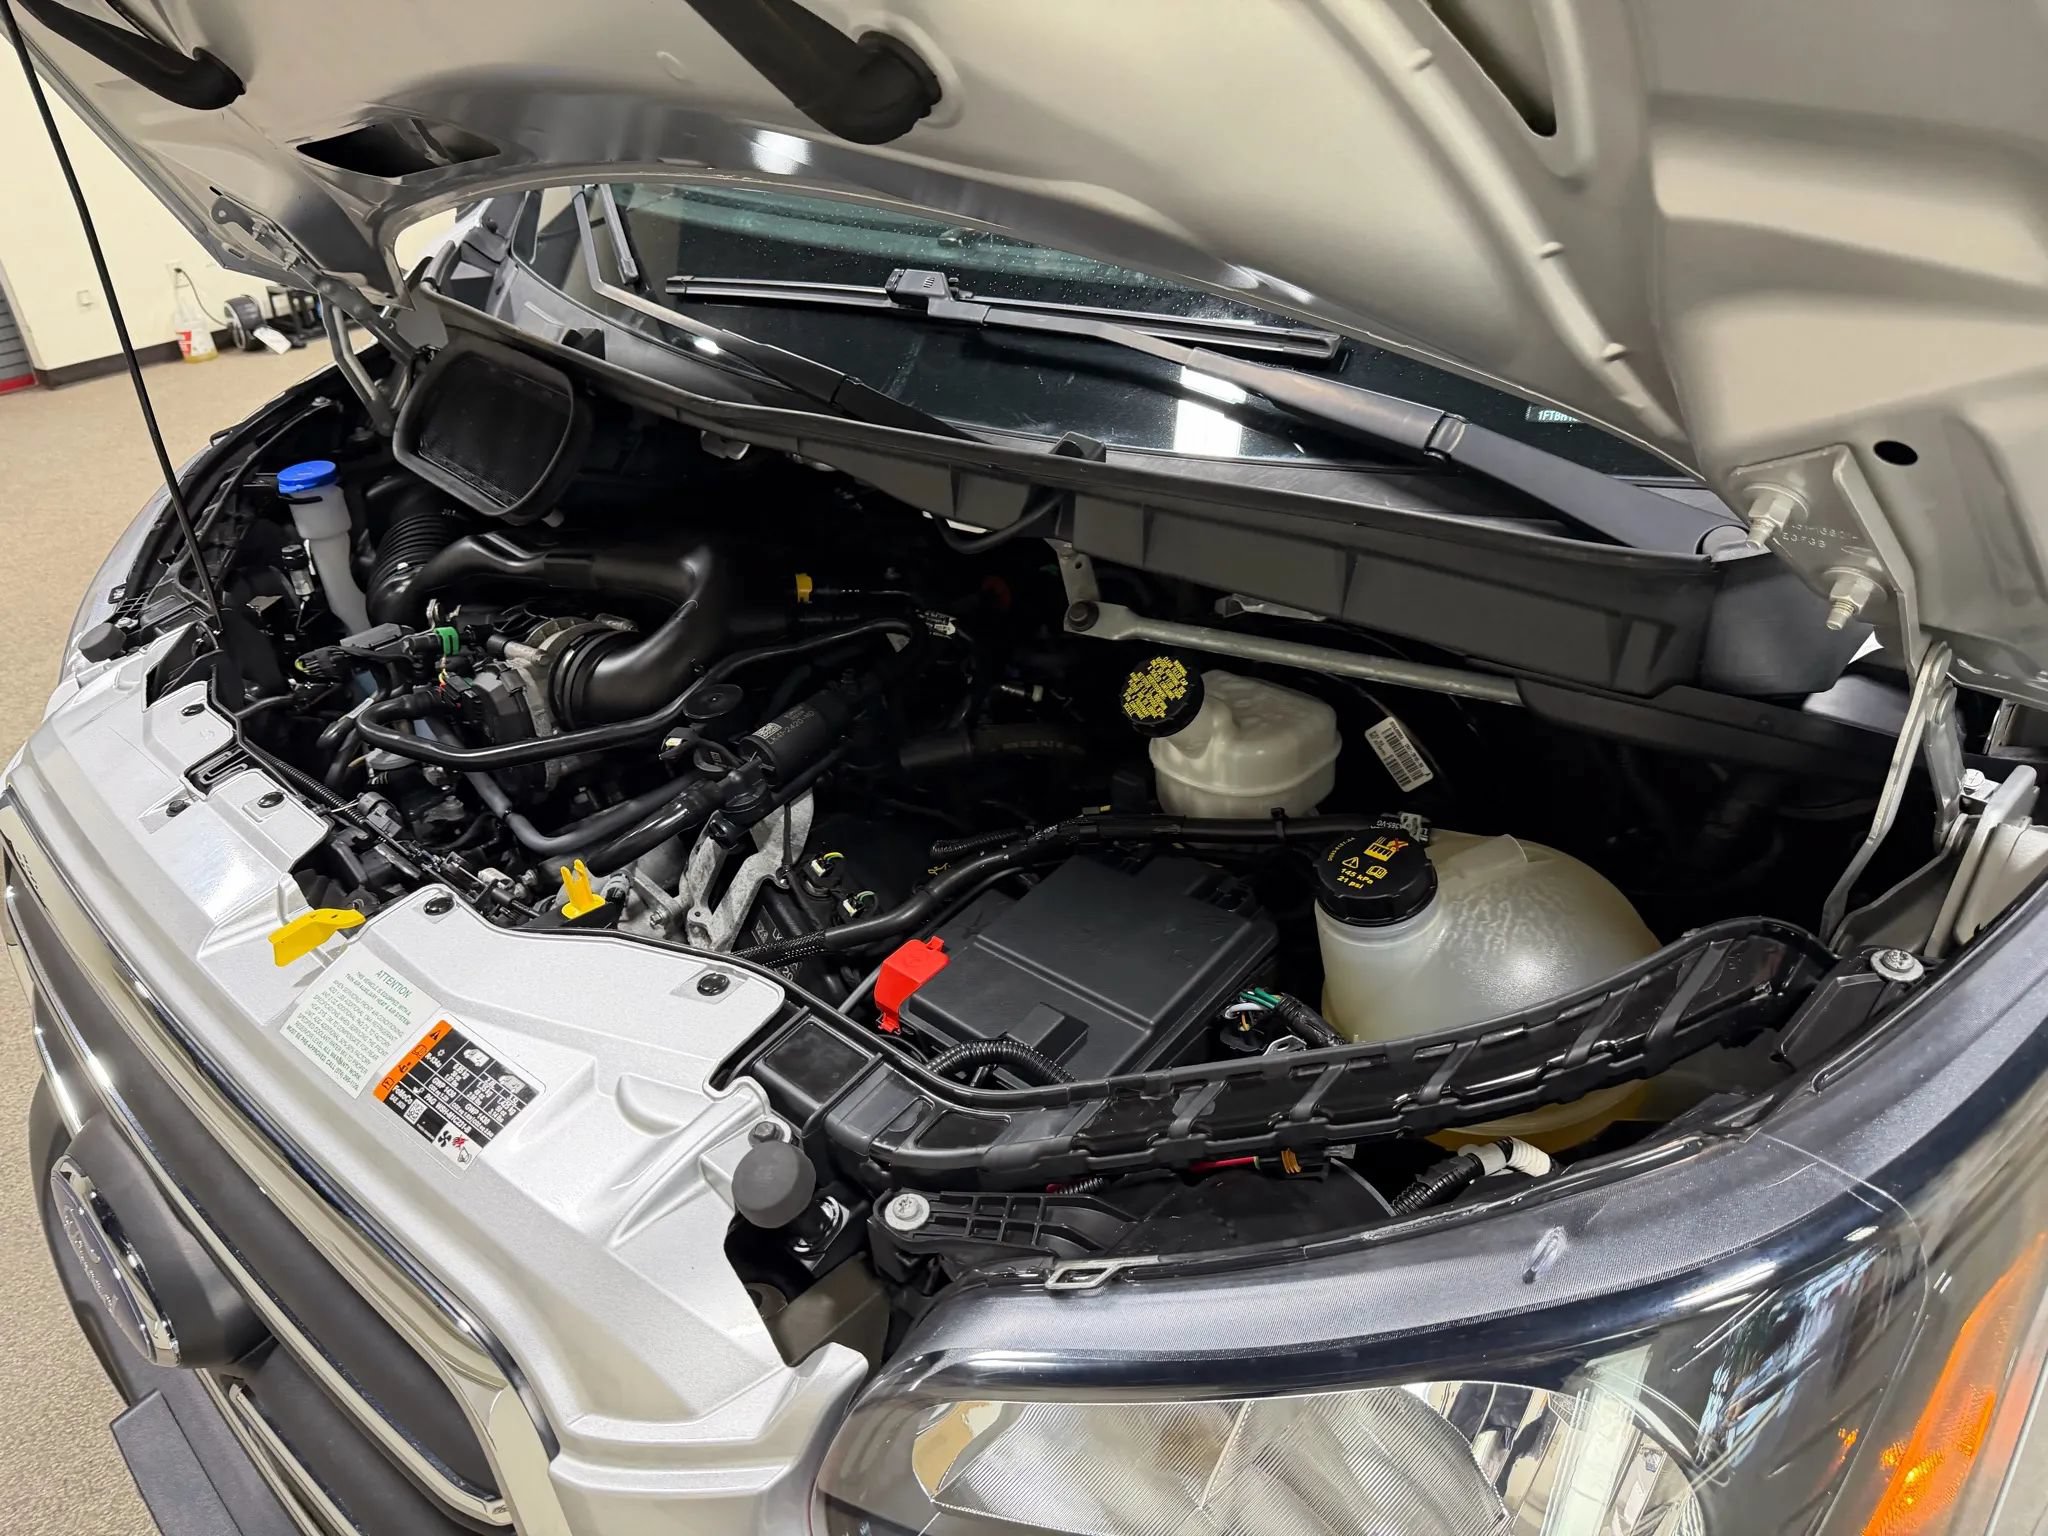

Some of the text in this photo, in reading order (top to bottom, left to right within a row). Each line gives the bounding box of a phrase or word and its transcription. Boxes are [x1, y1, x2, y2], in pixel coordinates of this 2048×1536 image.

[1341, 868, 1374, 884] 145 kPa
[1348, 881, 1364, 889] psi
[374, 968, 412, 998] ATTENTION
[380, 990, 399, 1006] EQUIPPED
[335, 1002, 356, 1020] ADDITIONAL
[343, 998, 364, 1016] ADDITIONAL
[375, 997, 386, 1007] HEAT
[393, 1011, 410, 1025] SYSTEM
[319, 1021, 341, 1040] ADDITIONAL
[353, 1049, 371, 1066] FACTORY
[366, 1038, 375, 1046] THE
[373, 1044, 388, 1057] FRONT
[322, 1045, 331, 1054] ALL
[329, 1051, 350, 1070] WARRANTY
[366, 1049, 379, 1060] REAR
[424, 1052, 443, 1068] R-134a
[324, 1058, 336, 1069] CALL
[459, 1070, 470, 1080] kg
[391, 1084, 414, 1104] FoMoCo
[430, 1076, 457, 1098] GWP 1430
[483, 1088, 494, 1098] kg
[388, 1093, 399, 1103] SAE
[423, 1093, 437, 1105] PAG
[463, 1102, 491, 1125] GWP 1430
